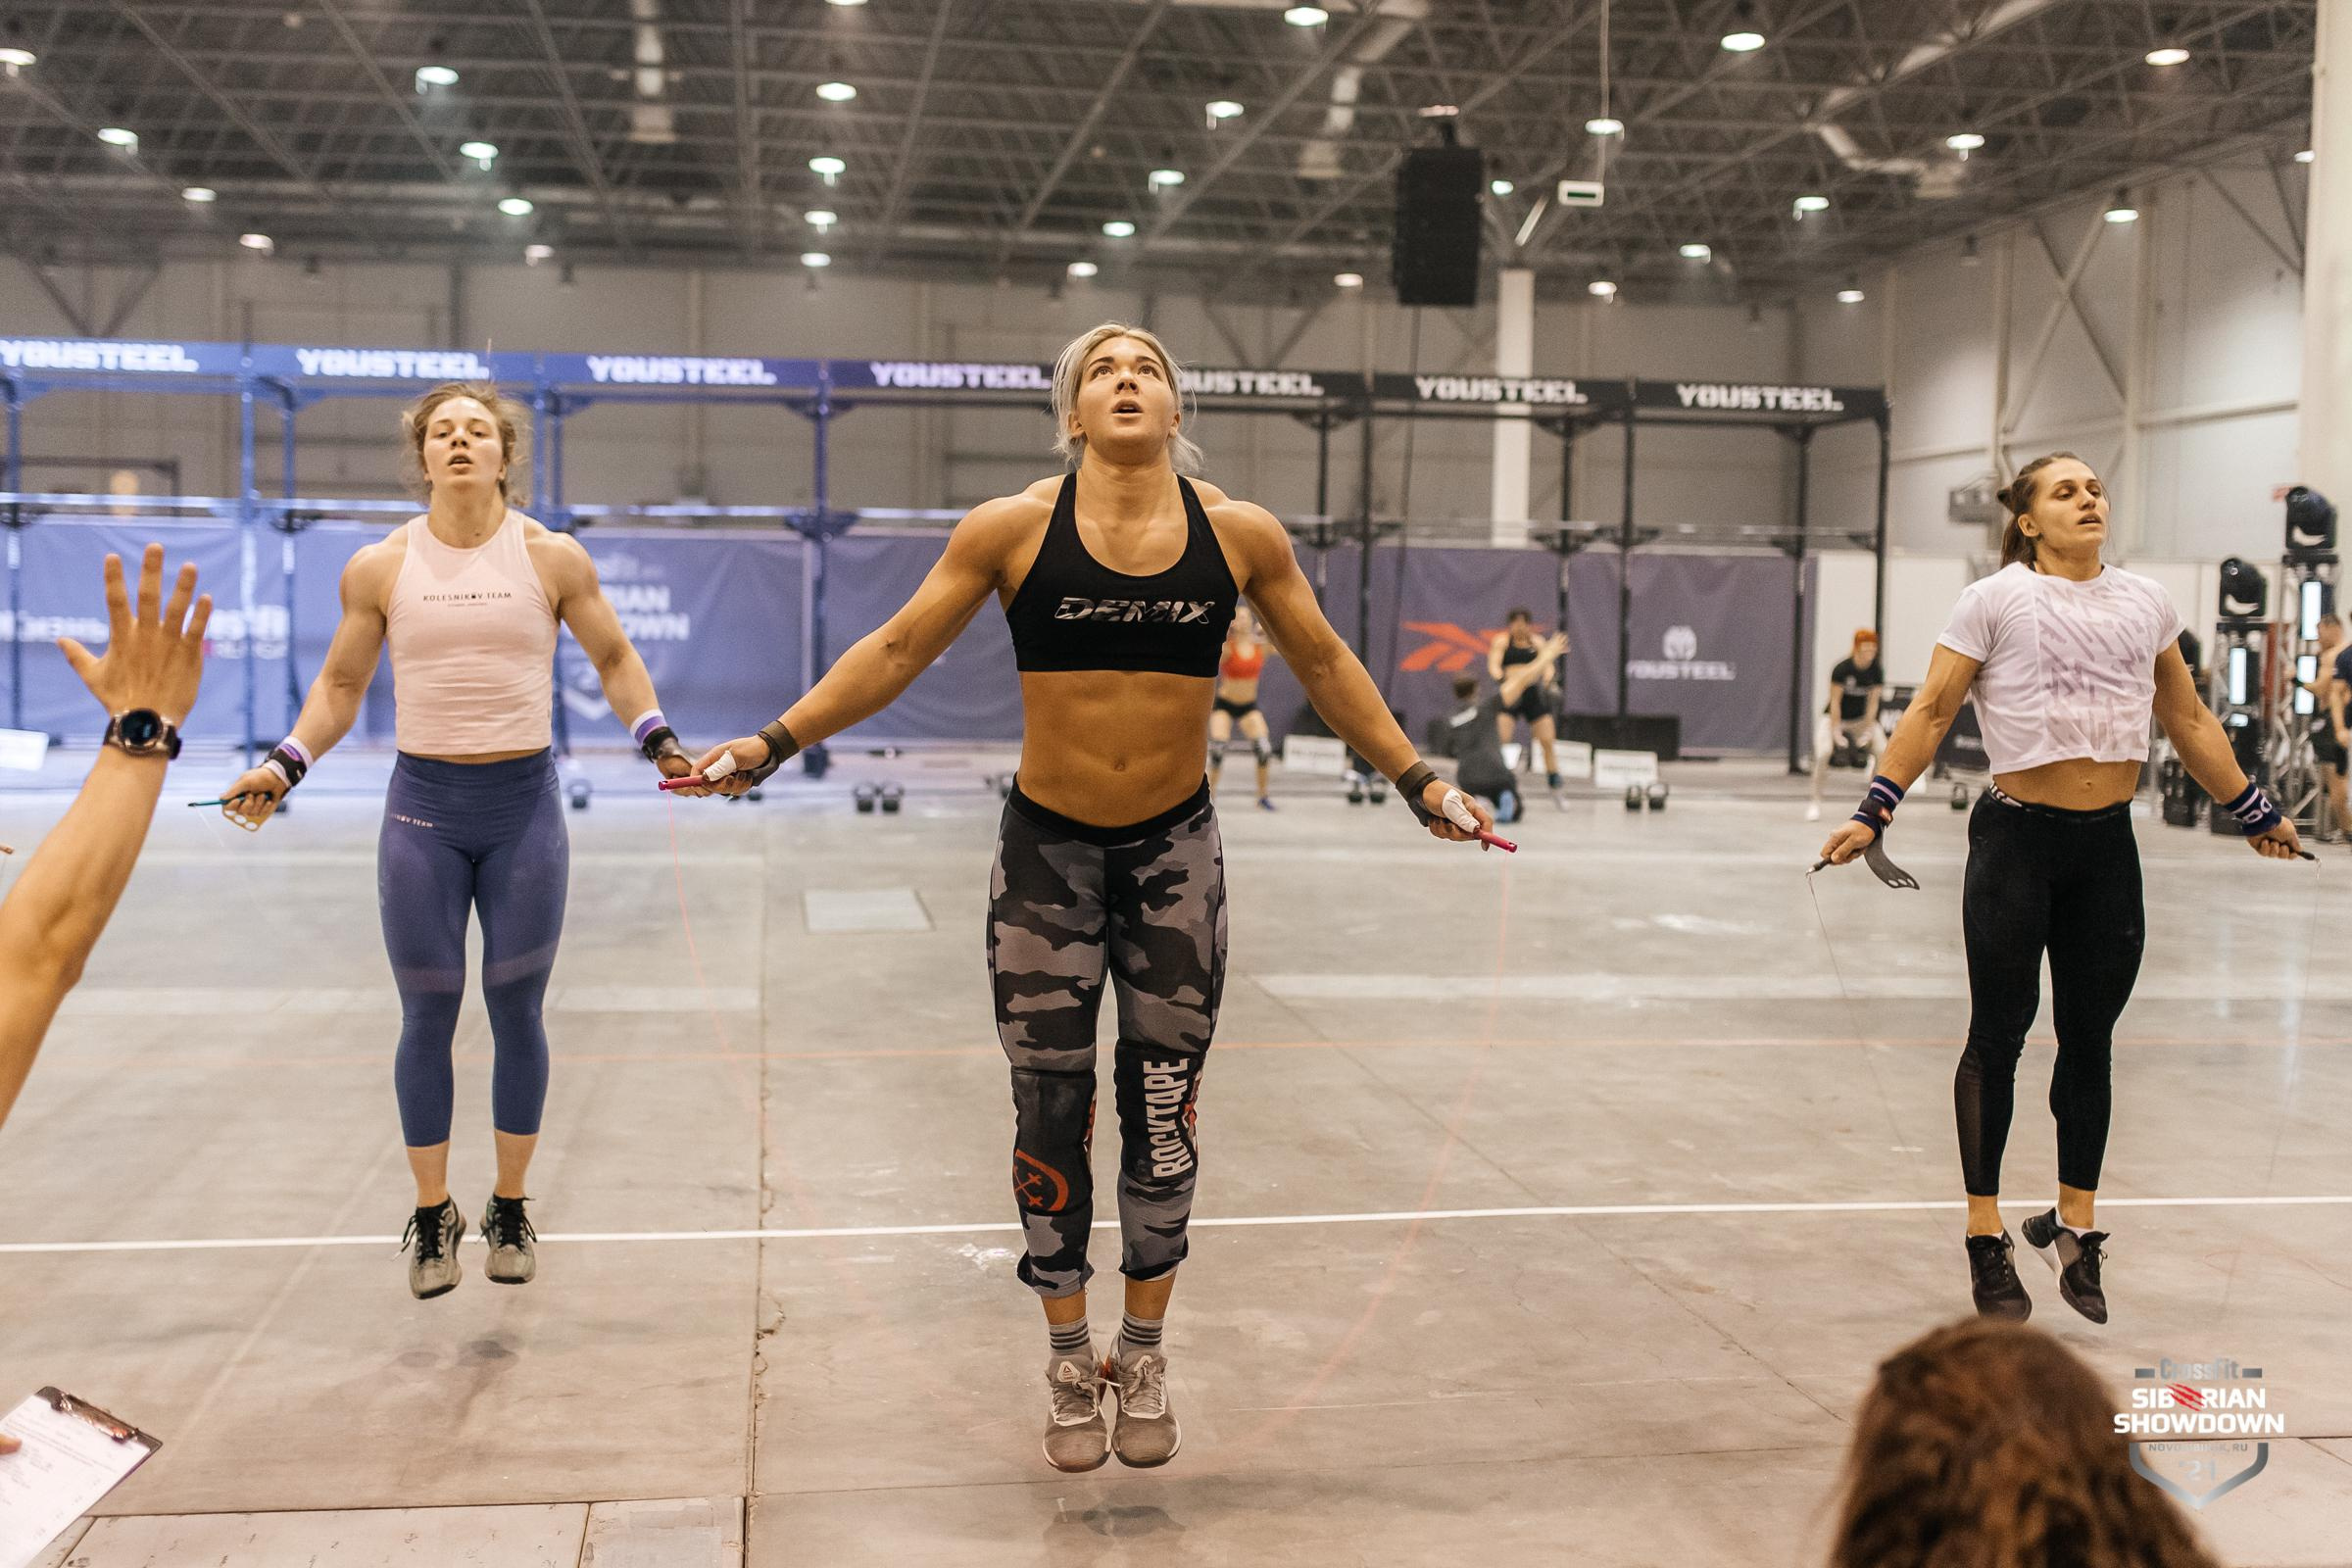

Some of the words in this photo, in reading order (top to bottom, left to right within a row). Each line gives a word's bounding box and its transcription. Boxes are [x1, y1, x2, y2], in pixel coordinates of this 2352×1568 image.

[0, 340, 200, 372] YOUSTEEL
[296, 348, 490, 380] YOUSTEEL
[586, 355, 778, 386] YOUSTEEL
[869, 362, 1053, 390] YOUSTEEL
[1177, 370, 1325, 397] OUSTEEL
[1415, 376, 1589, 405] YOUSTEEL
[1676, 383, 1844, 412] YOUSTEEL
[1054, 596, 1216, 624] DEMIX
[1143, 1057, 1193, 1177] ROCKTAPE
